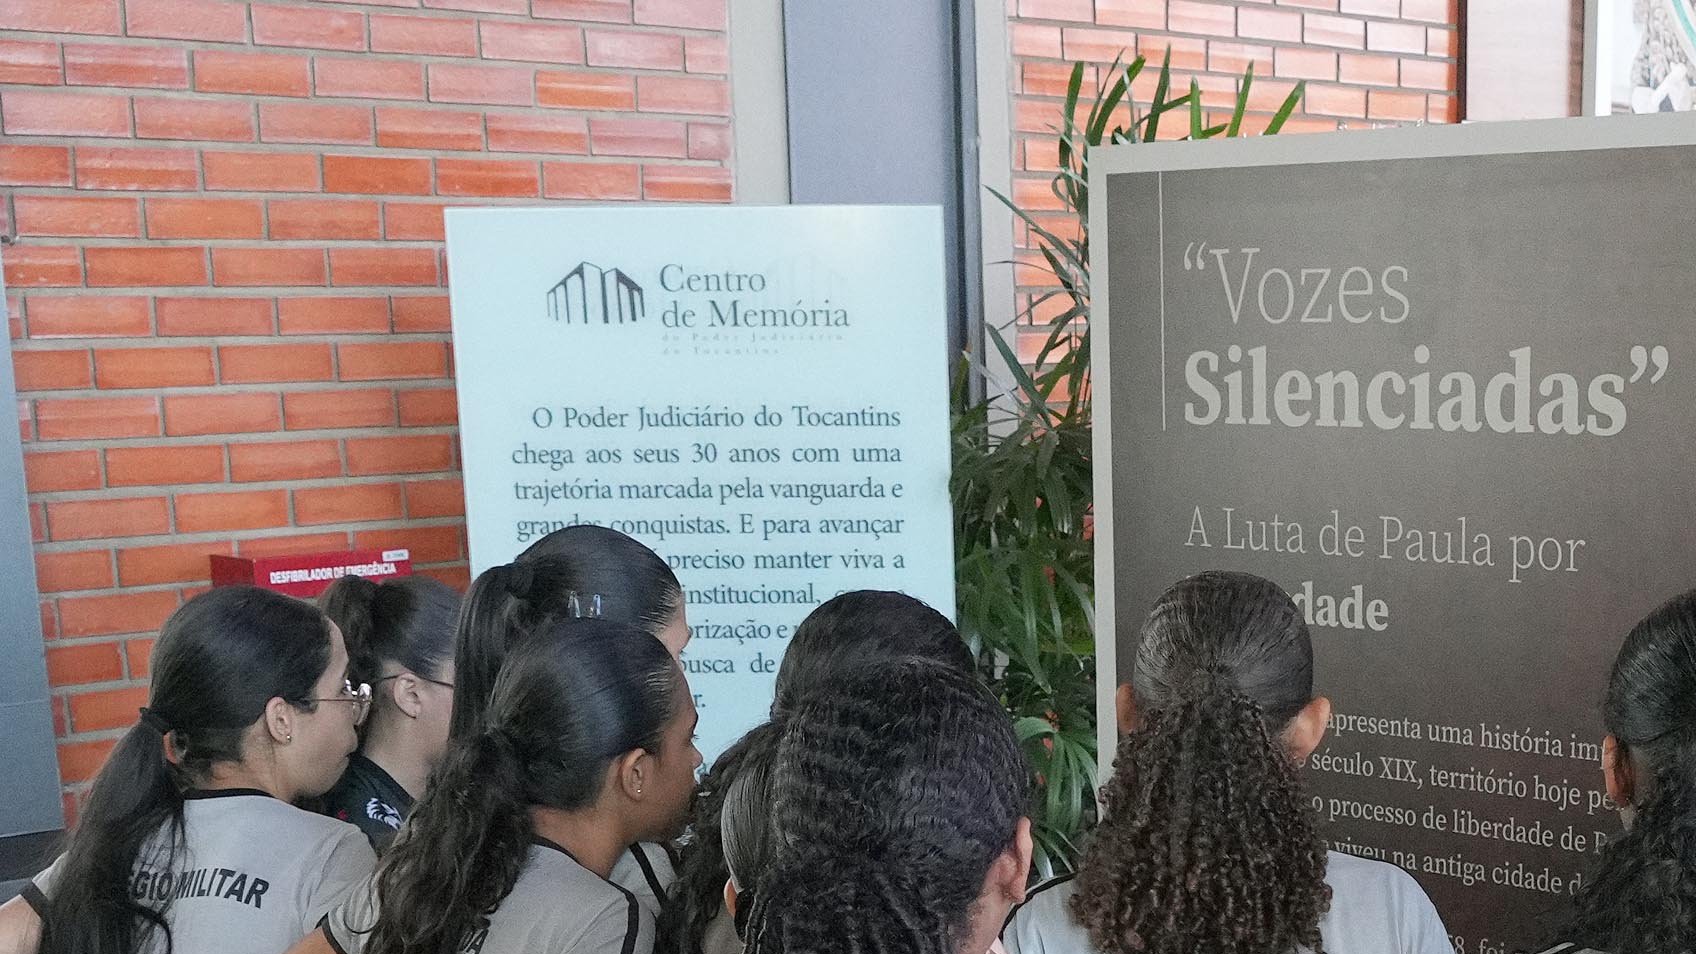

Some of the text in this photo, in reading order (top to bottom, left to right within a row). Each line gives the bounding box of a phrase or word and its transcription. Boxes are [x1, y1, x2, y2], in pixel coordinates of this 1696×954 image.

[659, 263, 766, 293] Centro
[661, 300, 850, 329] de Memória
[1184, 344, 1669, 437] Silenciadas”
[532, 405, 901, 431] O Poder Judiciário do Tocantins
[511, 442, 902, 471] chega aos seus 30 anos com uma
[514, 478, 904, 507] trajetória marcada pela vanguarda e
[610, 515, 731, 541] conquistas.
[739, 515, 755, 534] E
[763, 519, 811, 541] para
[818, 518, 905, 543] avançar
[667, 548, 905, 569] preciso manter viva a
[1184, 505, 1587, 584] A Luta de Paula por
[269, 567, 333, 585] DESFIBRILADOR
[333, 566, 345, 578] DE
[776, 624, 788, 639] e
[750, 652, 776, 674] de
[1427, 723, 1474, 748] uma
[1479, 722, 1564, 757] história
[1311, 747, 1374, 777] século
[1379, 756, 1424, 790] XIX,
[1429, 765, 1527, 798] território
[1532, 774, 1581, 811] hoje
[1312, 795, 1324, 813] o
[1328, 797, 1417, 827] processo
[1422, 805, 1447, 831] de
[1451, 808, 1554, 848] liberdade
[1560, 825, 1587, 853] de
[1391, 849, 1418, 871] na
[1422, 853, 1486, 887] antiga
[1491, 860, 1563, 894] cidade
[175, 867, 270, 909] MILITAR
